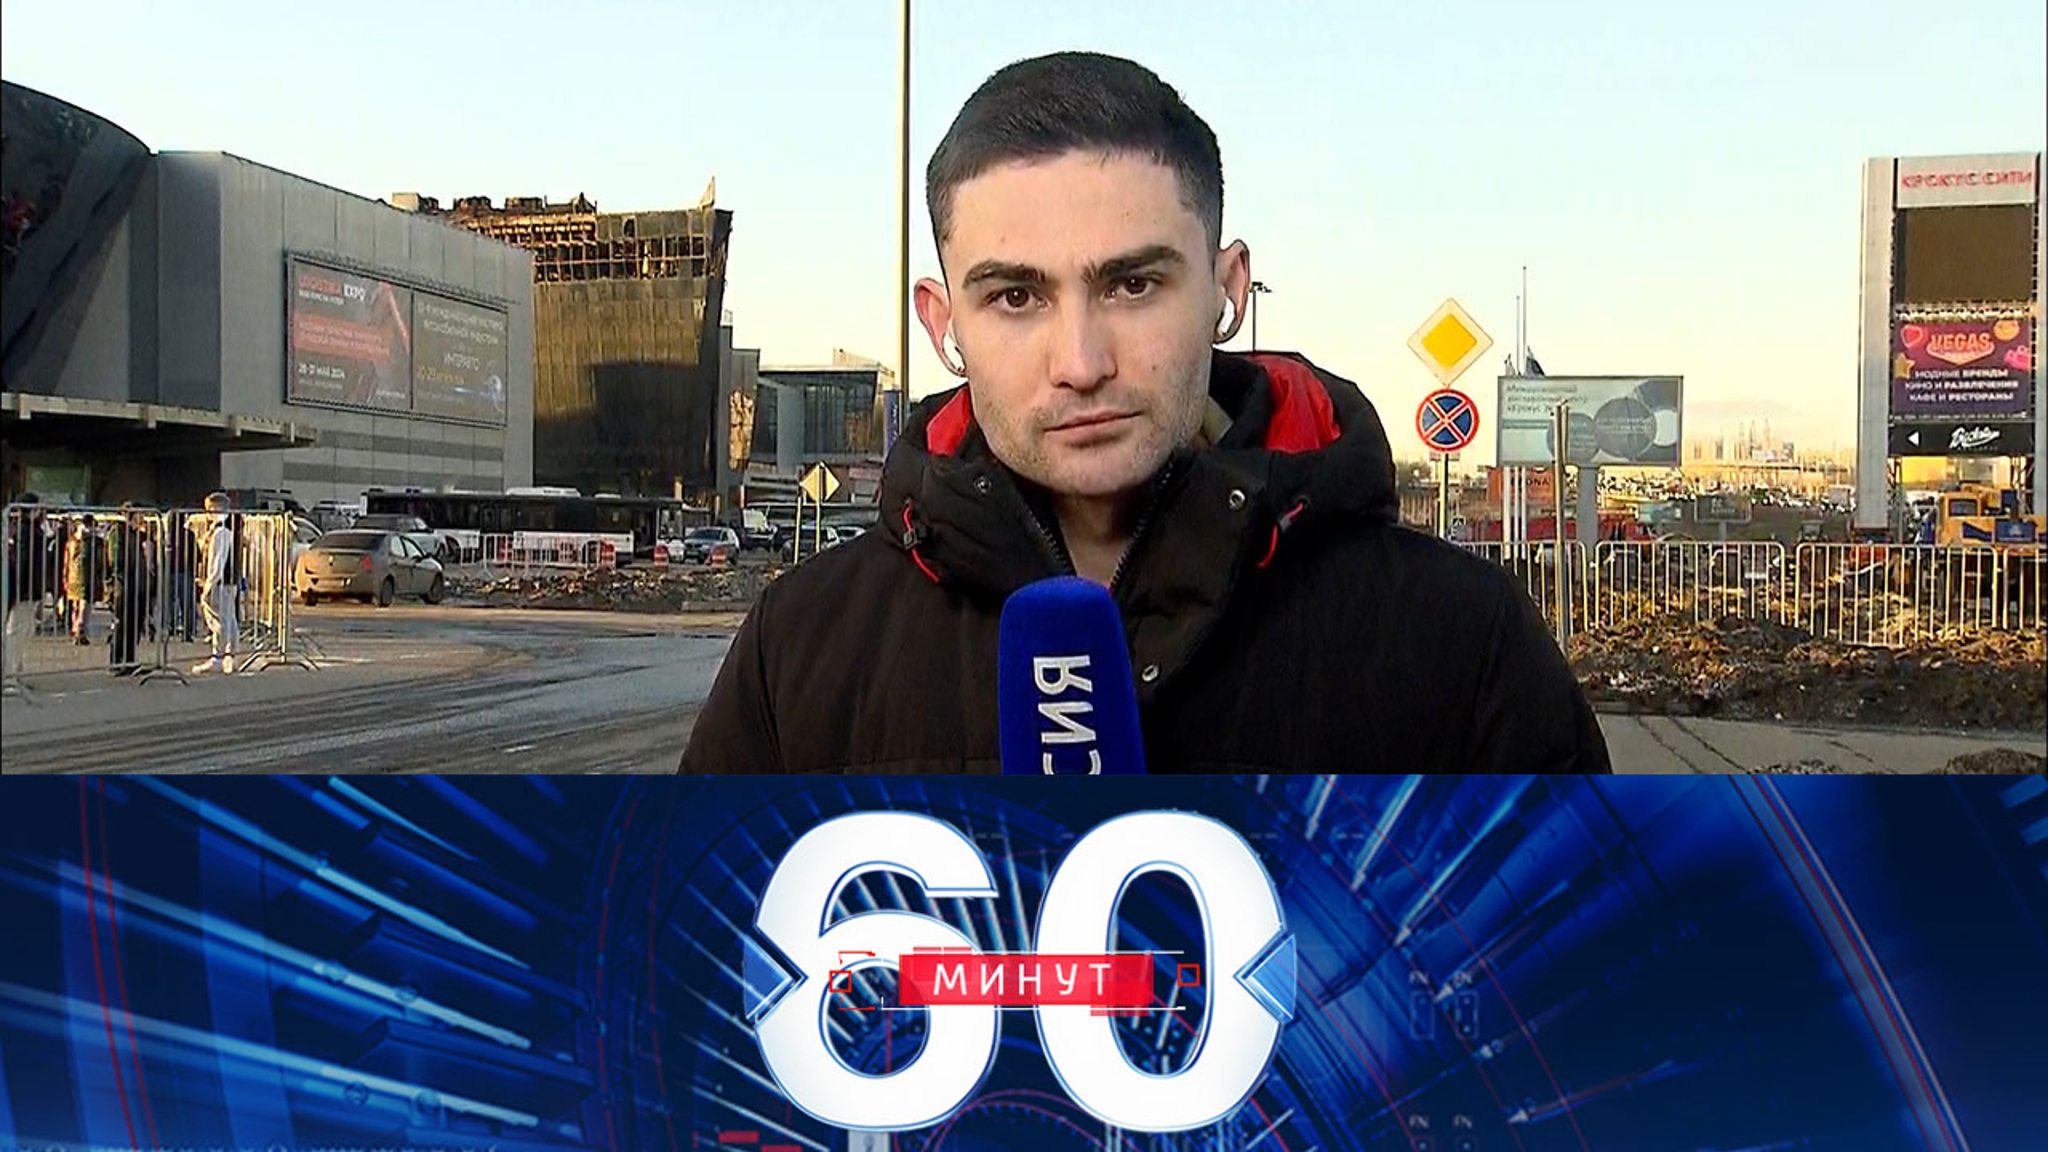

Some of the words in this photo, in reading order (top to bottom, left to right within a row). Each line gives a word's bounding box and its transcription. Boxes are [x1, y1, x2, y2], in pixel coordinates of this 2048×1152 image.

[1930, 332, 1990, 352] VEGAS
[1915, 369, 1960, 380] МОДНЫЕ
[1962, 368, 2009, 378] БРЕНДЫ
[1905, 382, 1933, 390] КИНО
[1944, 380, 2018, 389] РАЗВЛЕЧЕНИЯ
[1909, 393, 1937, 402] КАФЕ
[1939, 393, 1946, 401] И
[1948, 392, 2014, 401] РЕСТОРАНЫ
